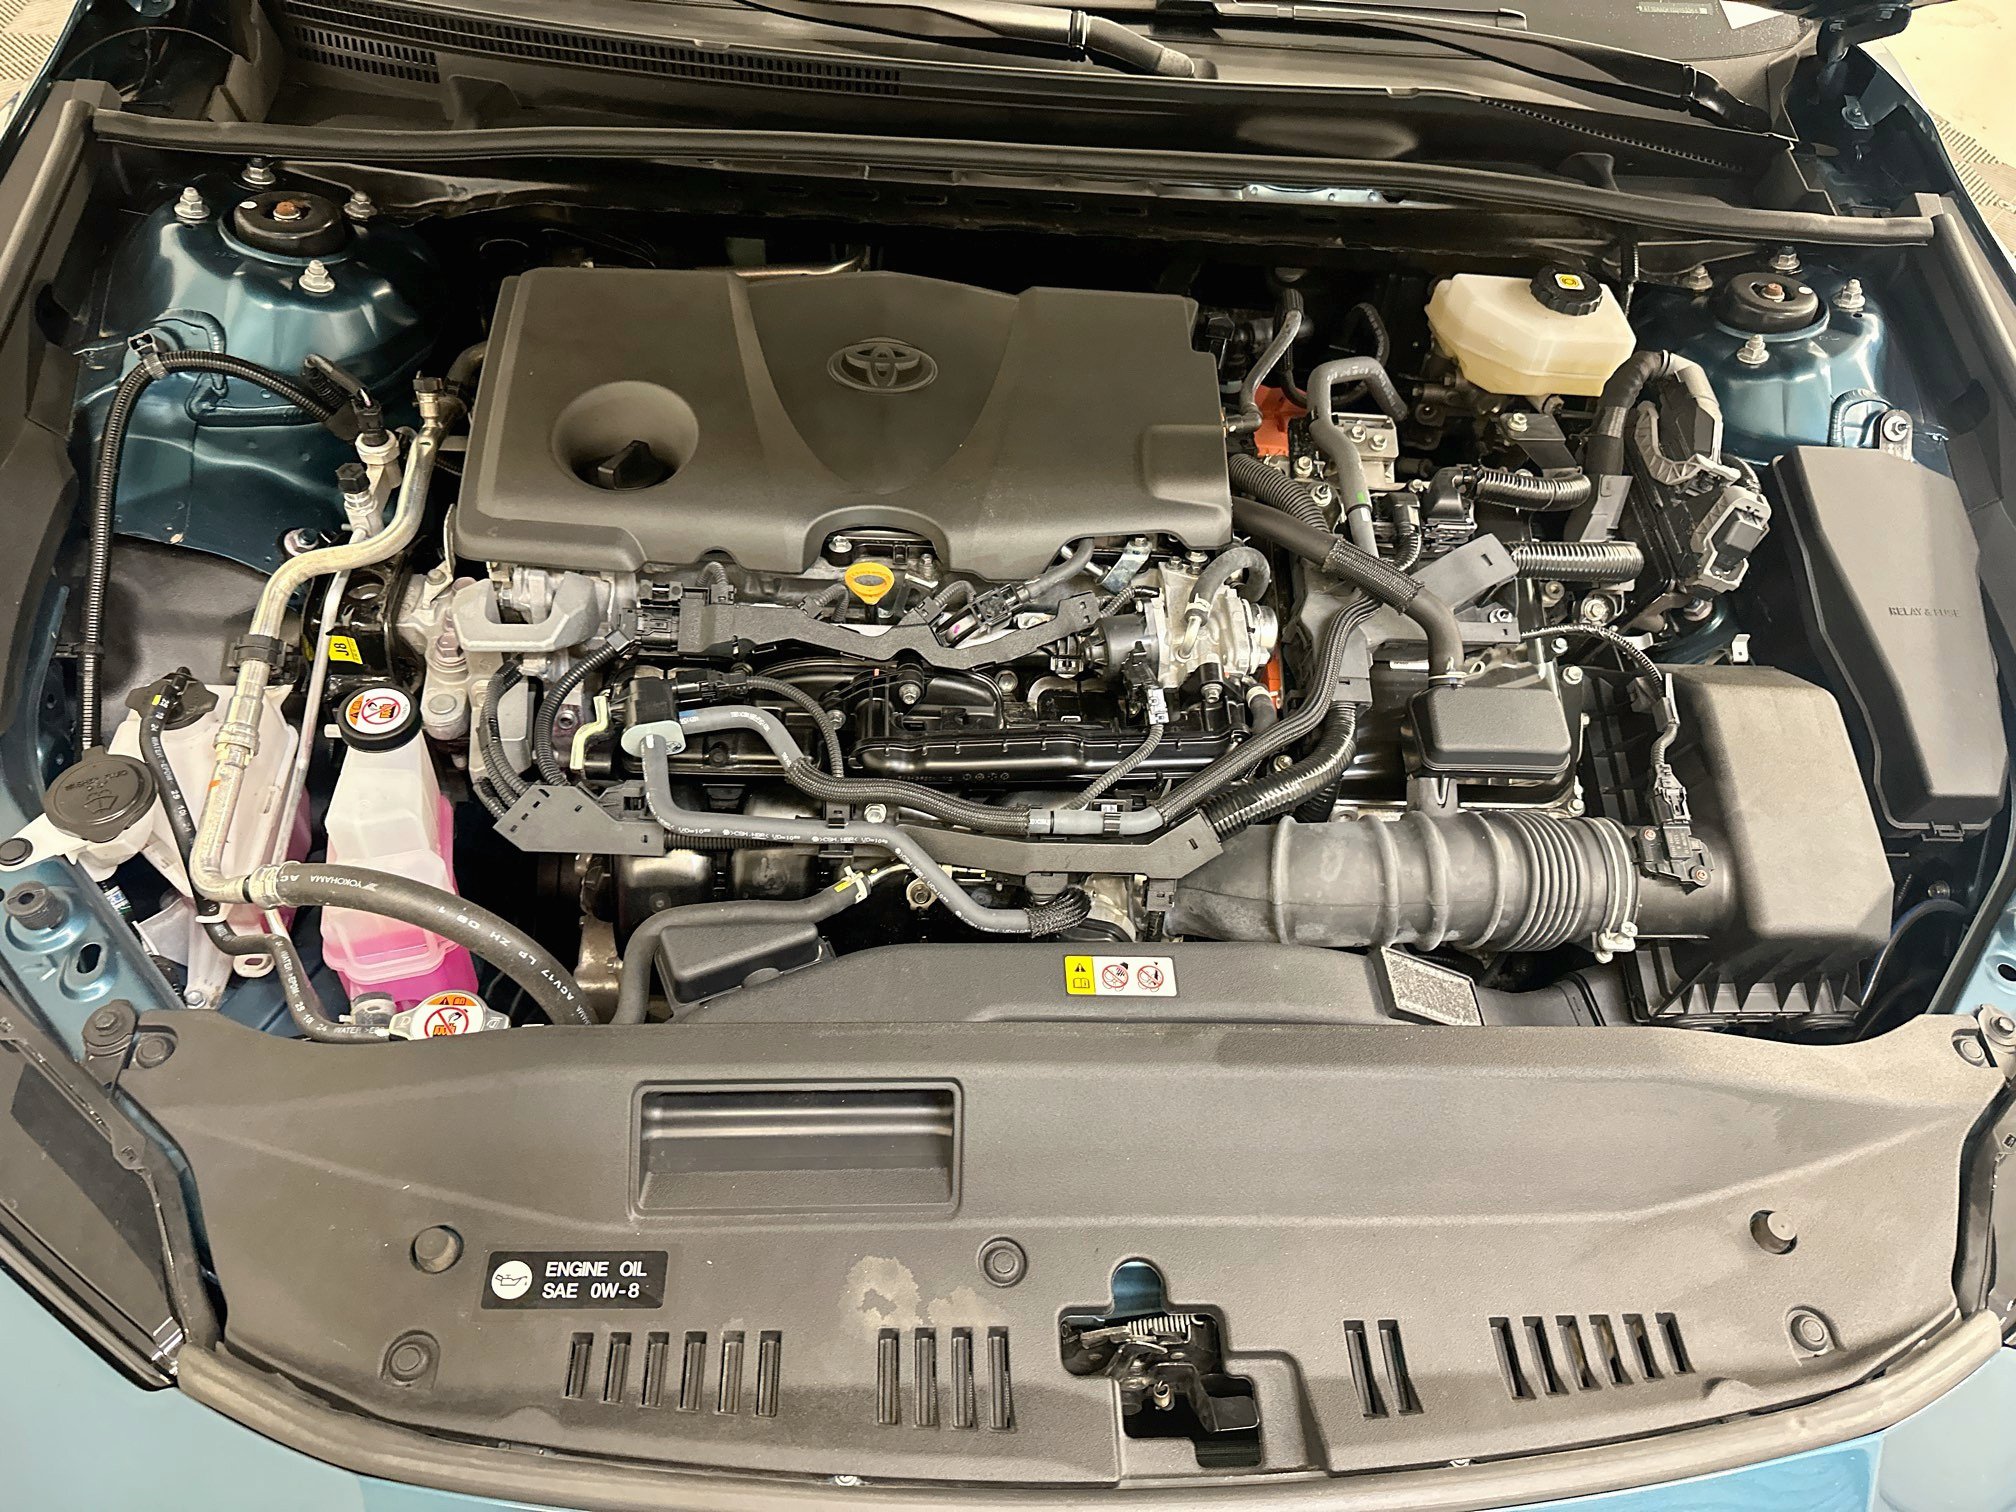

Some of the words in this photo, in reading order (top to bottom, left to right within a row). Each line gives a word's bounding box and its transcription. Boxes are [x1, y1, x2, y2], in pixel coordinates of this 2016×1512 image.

[1888, 606, 1921, 616] RELAY
[334, 643, 349, 657] J8
[310, 874, 362, 889] YOKOHAMA
[489, 931, 512, 947] ZH
[518, 950, 537, 966] LP
[541, 969, 575, 1001] ACV17
[316, 1023, 328, 1031] 24
[333, 1026, 361, 1034] WATER
[545, 1261, 609, 1277] ENGINE
[619, 1261, 647, 1277] OIL
[542, 1283, 578, 1298] SAE
[590, 1283, 640, 1298] 0W-8
